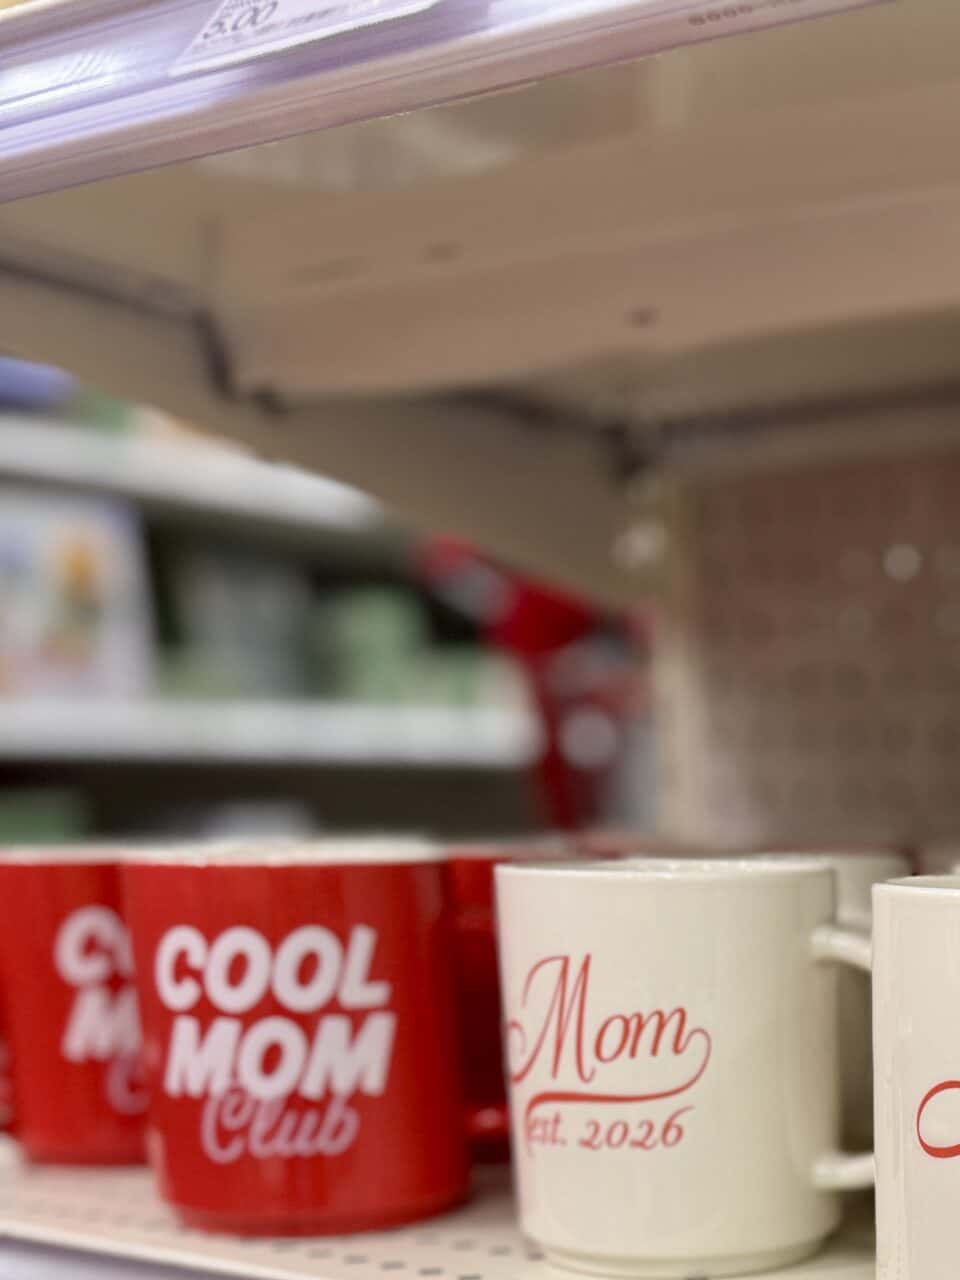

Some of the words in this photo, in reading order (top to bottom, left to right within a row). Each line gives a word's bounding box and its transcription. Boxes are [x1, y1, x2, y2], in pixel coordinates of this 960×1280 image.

[155, 923, 391, 1012] COOL
[164, 1011, 397, 1098] MOM
[508, 953, 712, 1103] Mom
[202, 1089, 359, 1163] Club
[578, 1104, 695, 1151] 2026
